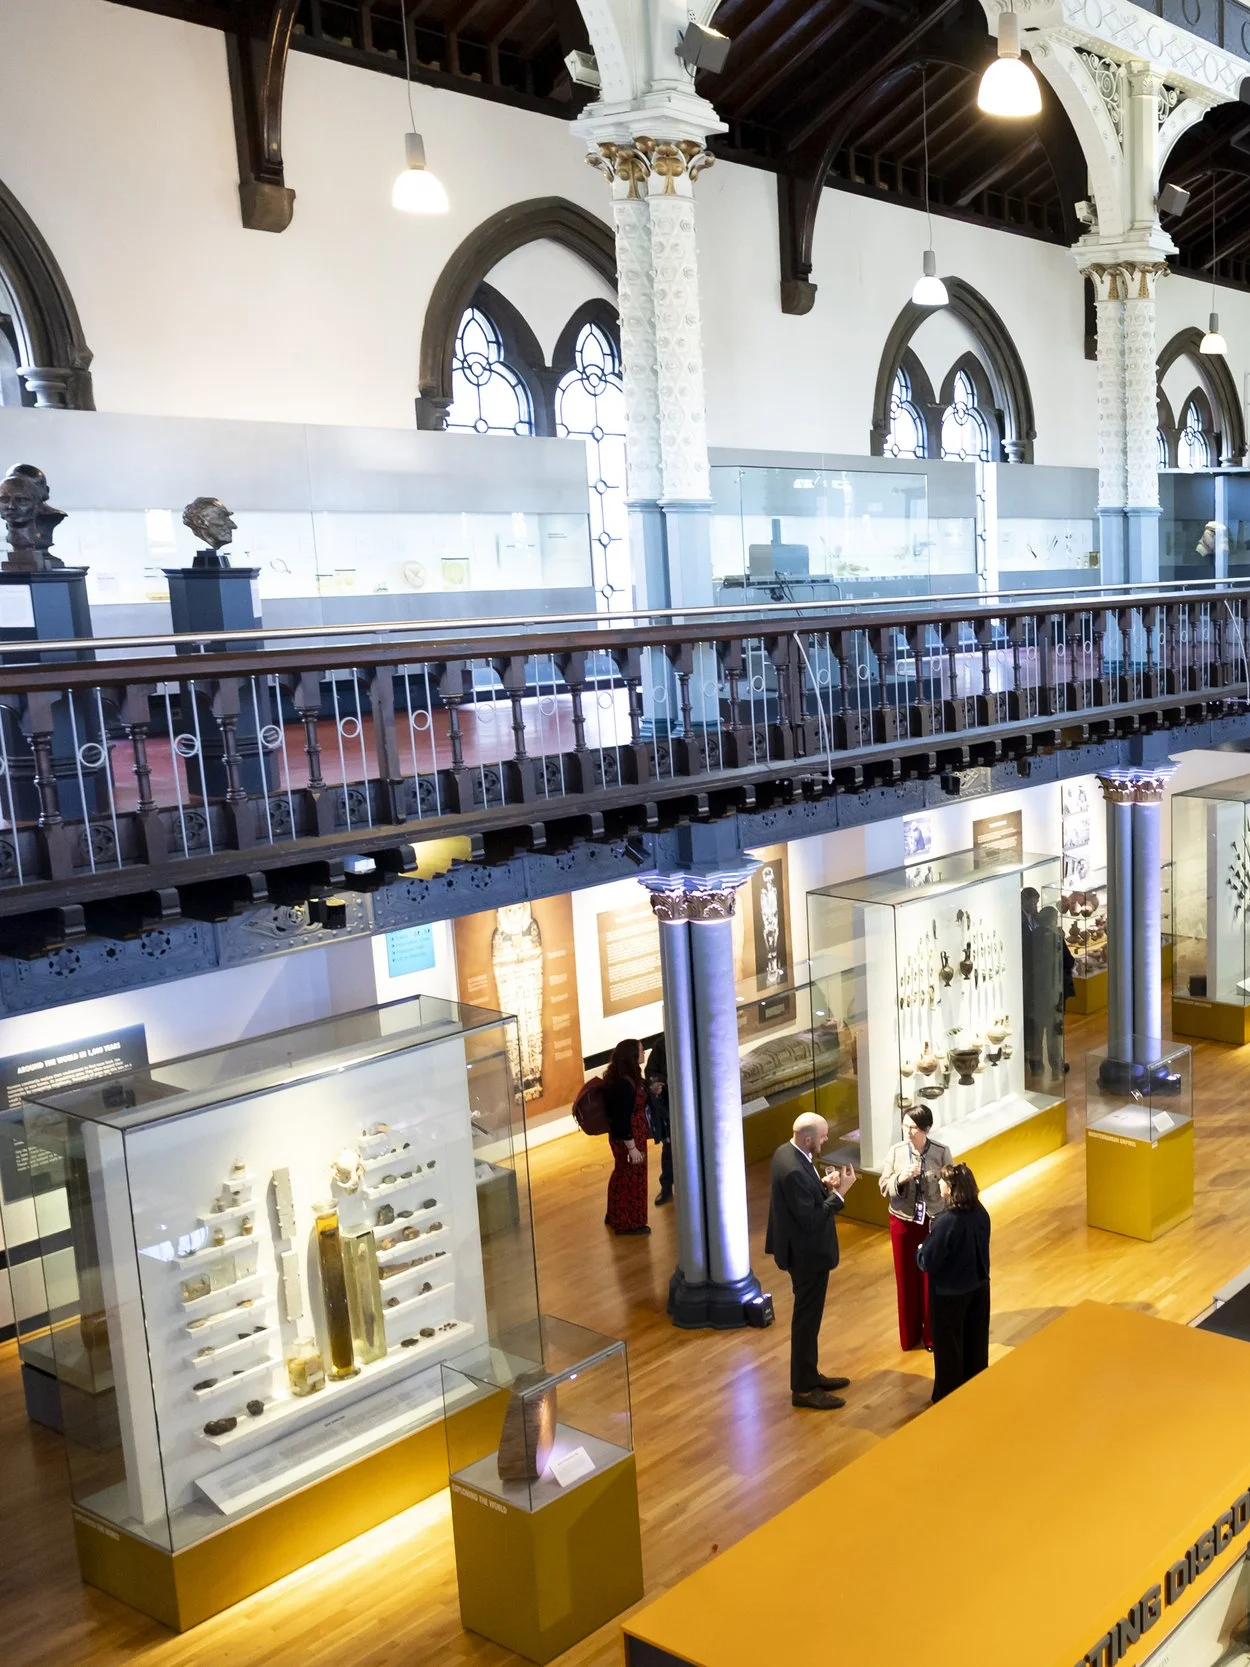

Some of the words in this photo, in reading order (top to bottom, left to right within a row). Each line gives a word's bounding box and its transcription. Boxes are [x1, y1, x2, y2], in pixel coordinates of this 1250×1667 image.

[18, 1062, 44, 1074] AROUND
[45, 1059, 57, 1067] THE
[57, 1053, 79, 1064] WORLD
[104, 1042, 121, 1052] YEARS
